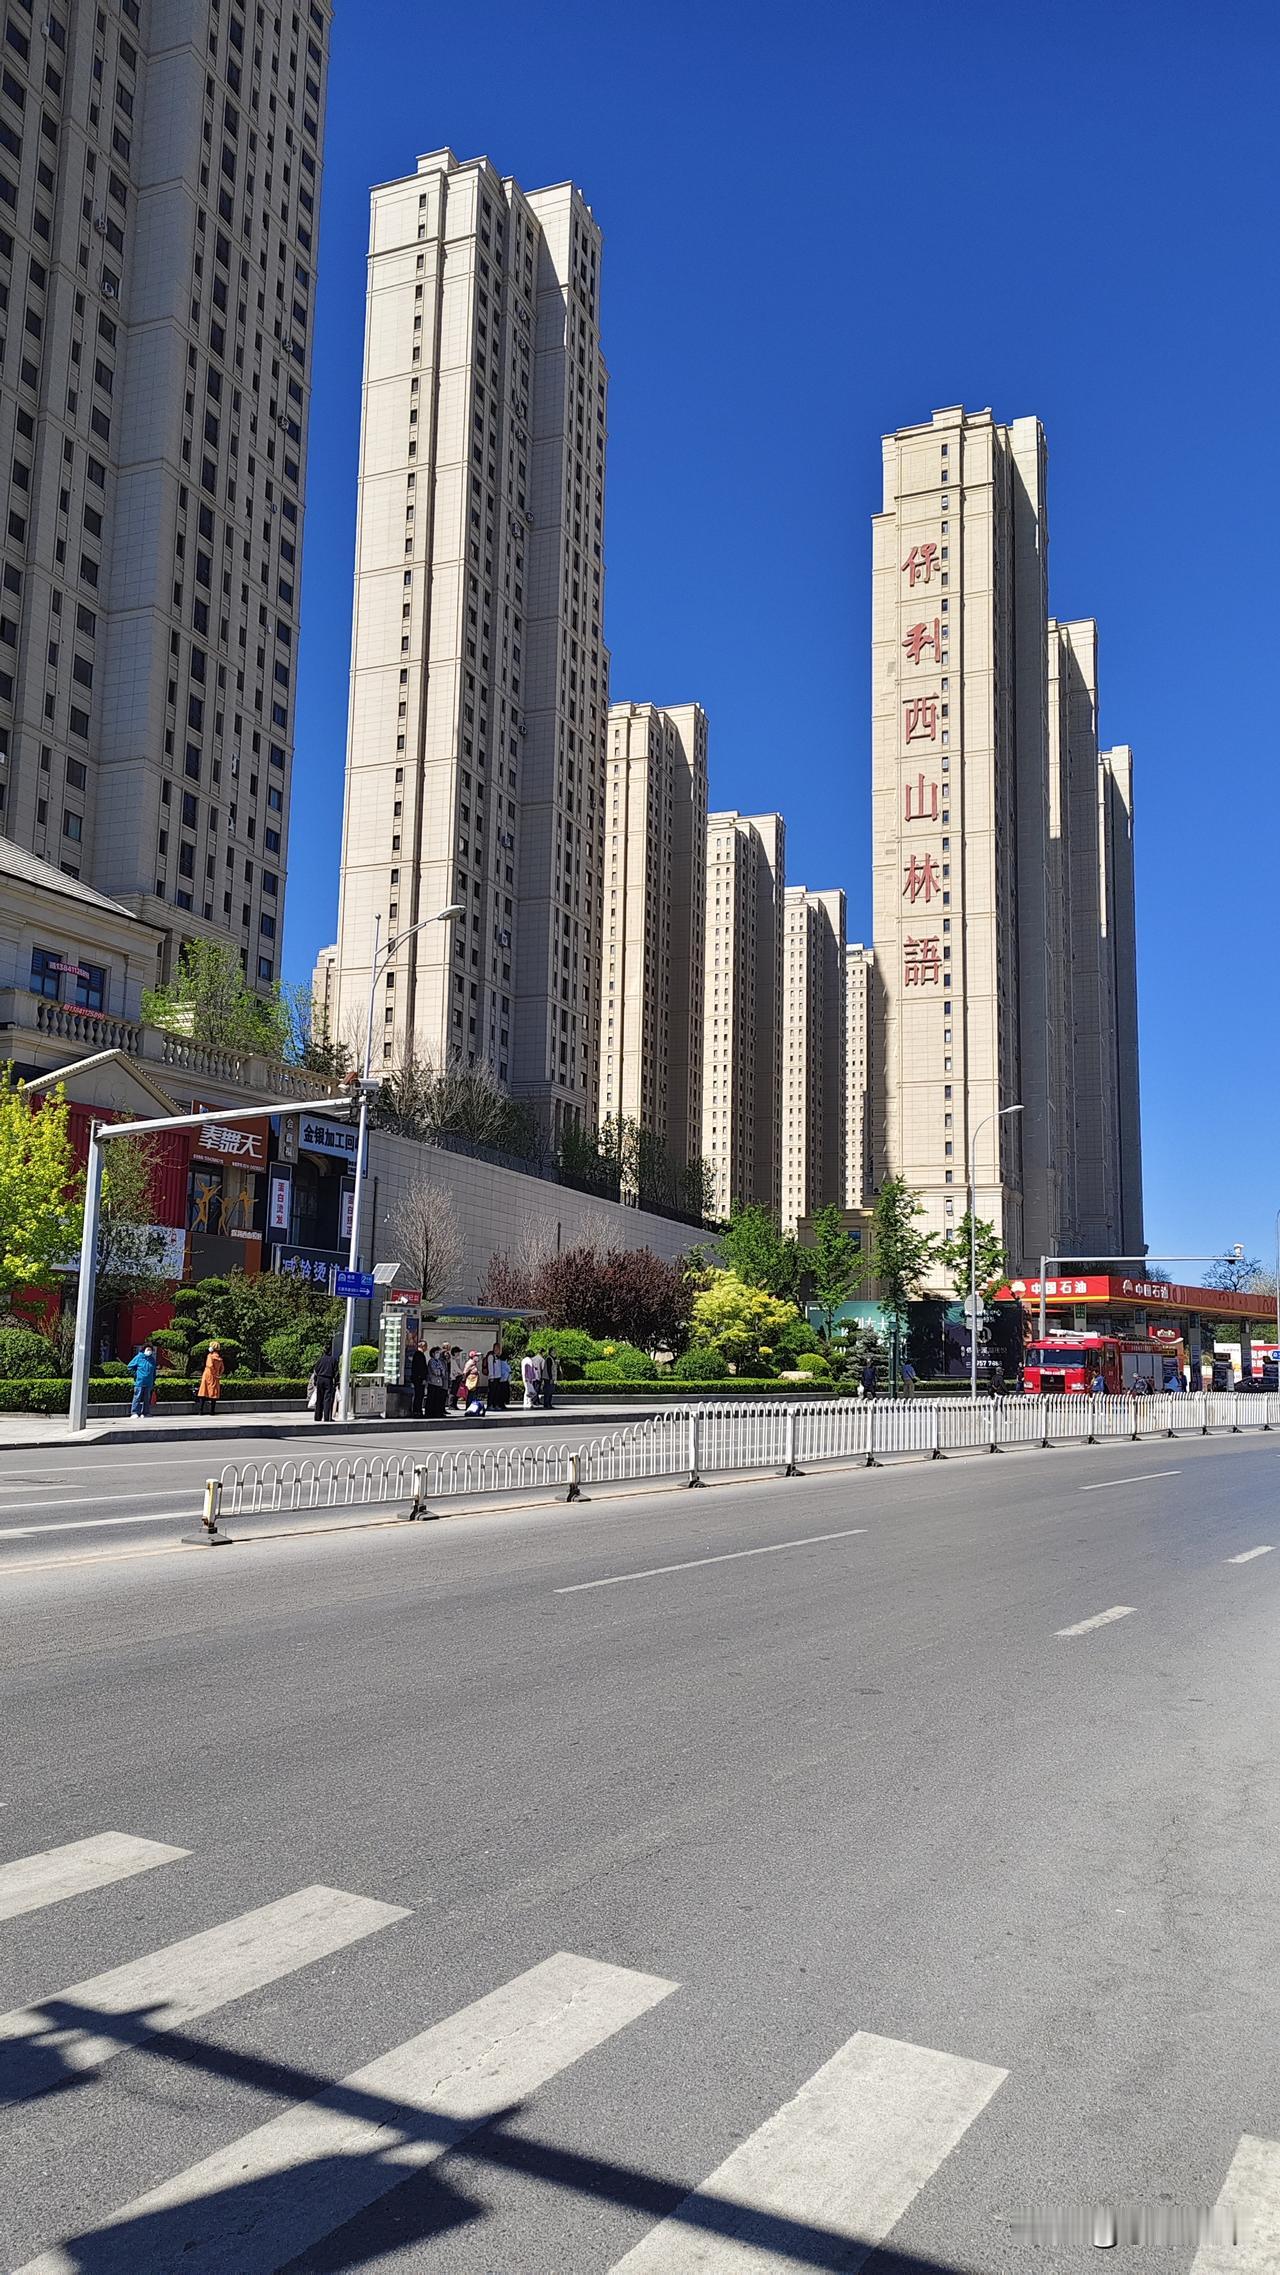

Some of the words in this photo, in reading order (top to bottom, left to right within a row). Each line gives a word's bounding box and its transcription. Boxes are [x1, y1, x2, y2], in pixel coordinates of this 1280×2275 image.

[901, 541, 943, 988] 保利西山林語
[1030, 1280, 1088, 1295] 中国石油
[1135, 1282, 1169, 1299] 中国石油
